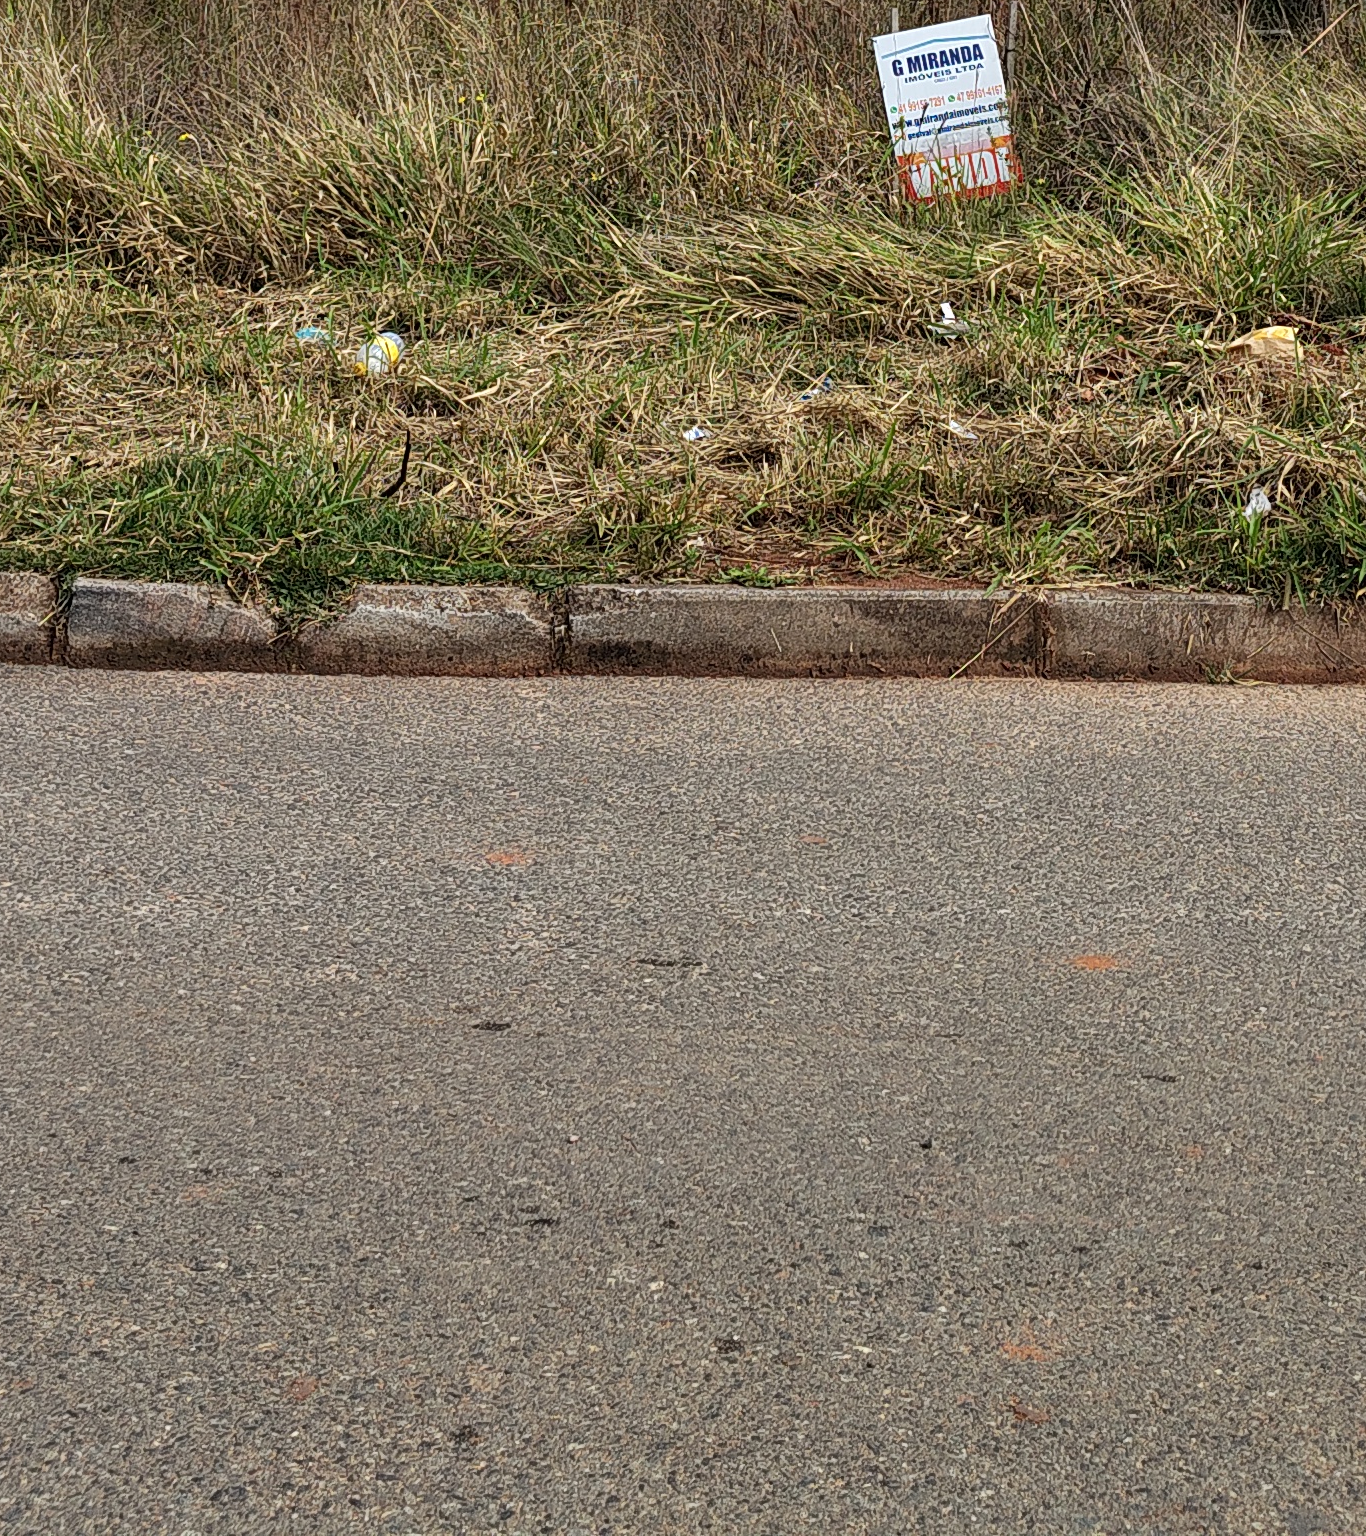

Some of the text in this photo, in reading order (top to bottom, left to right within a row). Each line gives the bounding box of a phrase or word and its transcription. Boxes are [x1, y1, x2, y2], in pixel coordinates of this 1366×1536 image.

[892, 44, 984, 76] G MIRANDA
[905, 69, 952, 83] IMÓVEIS
[955, 63, 984, 74] LTDA
